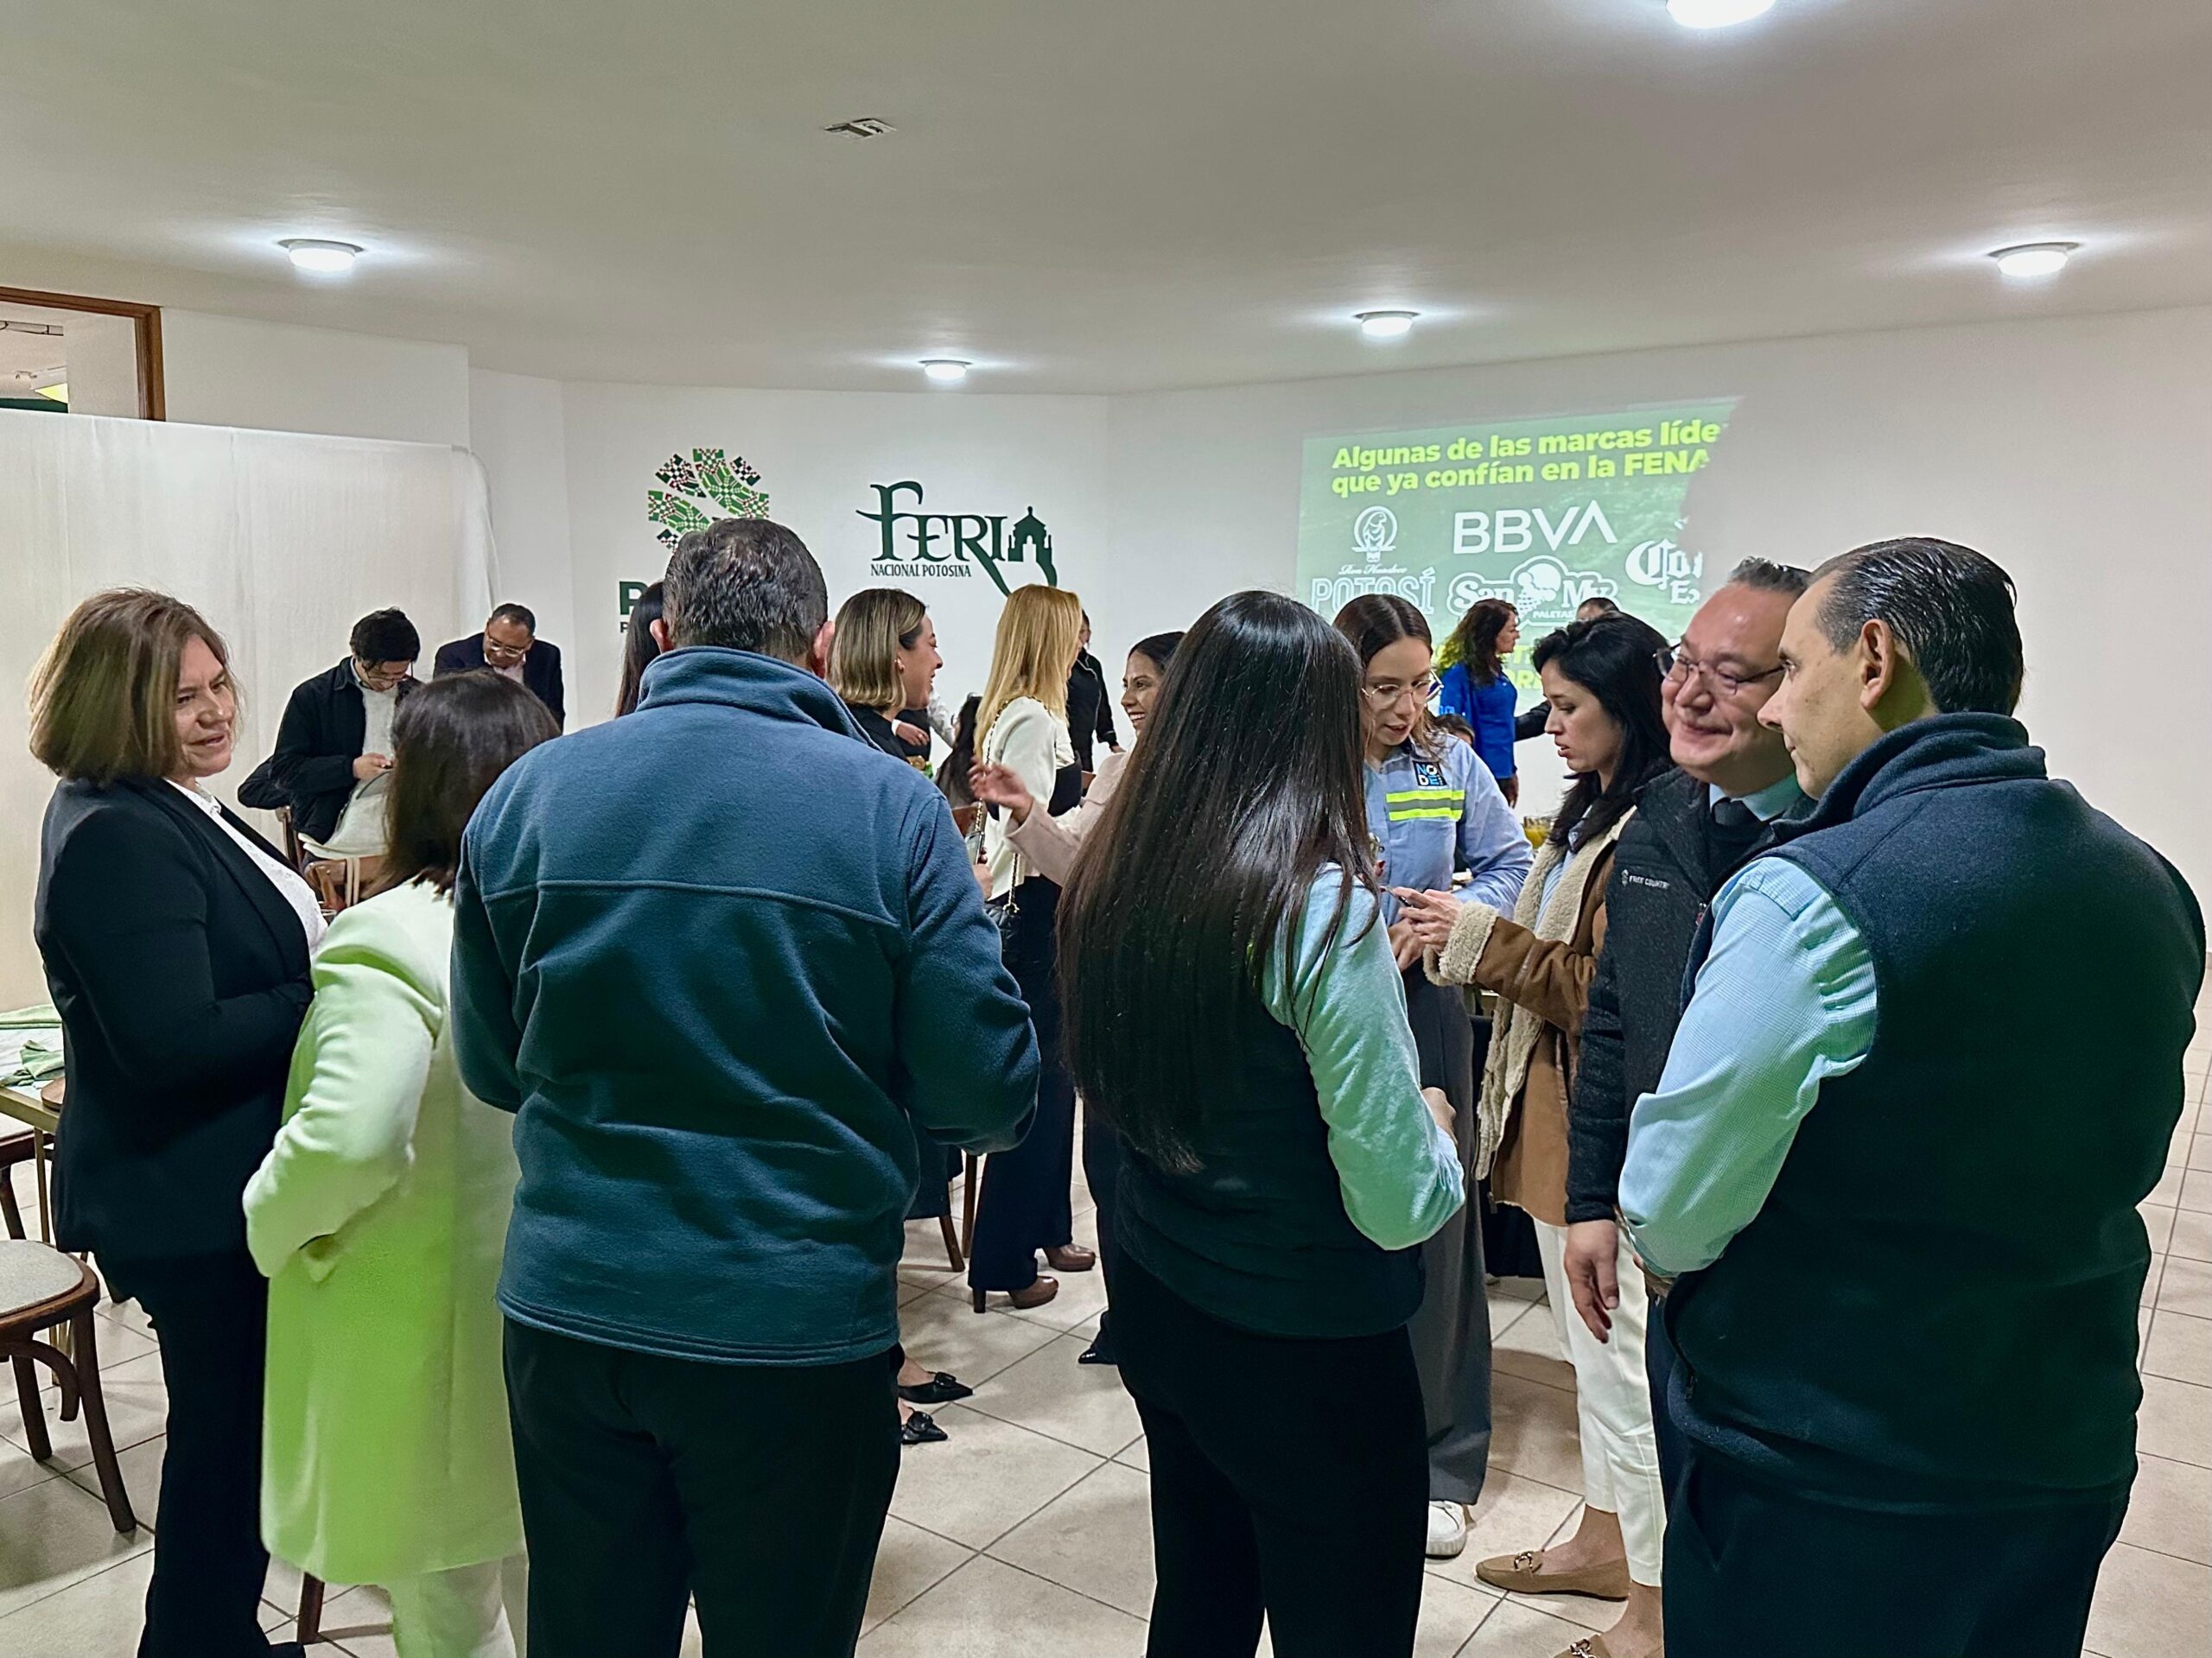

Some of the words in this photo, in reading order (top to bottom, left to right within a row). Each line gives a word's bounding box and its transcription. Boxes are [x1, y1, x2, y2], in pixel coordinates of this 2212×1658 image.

[1332, 444, 1441, 472] Algunas
[1447, 437, 1484, 461] de
[1490, 435, 1532, 458] las
[1538, 428, 1652, 454] marcas
[1660, 419, 1722, 447] líde
[1332, 474, 1382, 498] que
[1387, 472, 1419, 496] ya
[1425, 461, 1534, 488] confían
[1541, 461, 1580, 481] en
[1587, 454, 1616, 479] la
[1453, 499, 1618, 554] BBVA
[870, 563, 920, 577] NACIONAL
[922, 564, 972, 577] POTOSINA
[1416, 763, 1438, 776] NO
[1418, 774, 1440, 786] DE
